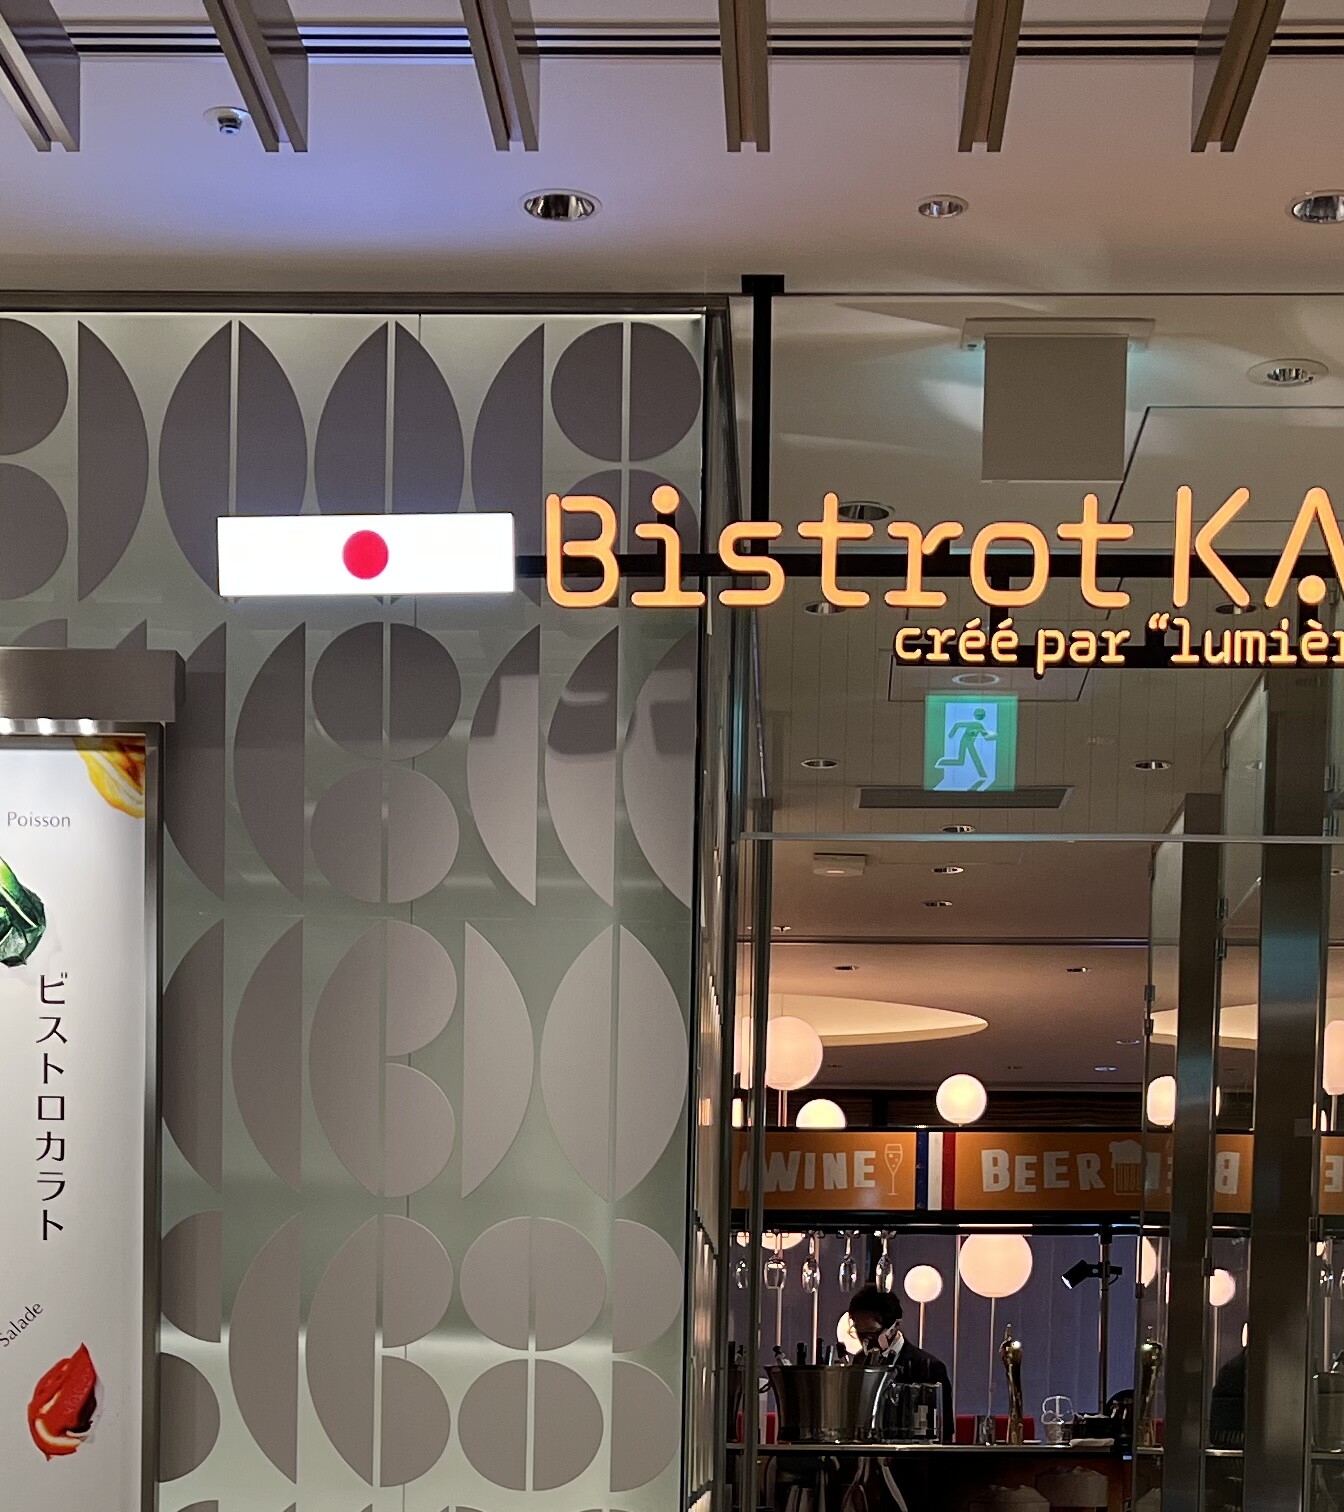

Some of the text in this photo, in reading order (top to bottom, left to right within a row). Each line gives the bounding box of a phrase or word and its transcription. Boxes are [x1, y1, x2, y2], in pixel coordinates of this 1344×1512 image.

[544, 485, 1134, 609] Bistrot
[895, 616, 1019, 664] créé
[1033, 627, 1132, 680] par
[6, 810, 72, 830] Poisson
[35, 972, 67, 1243] ビストロカラト
[761, 1148, 1106, 1195] WINE BEER
